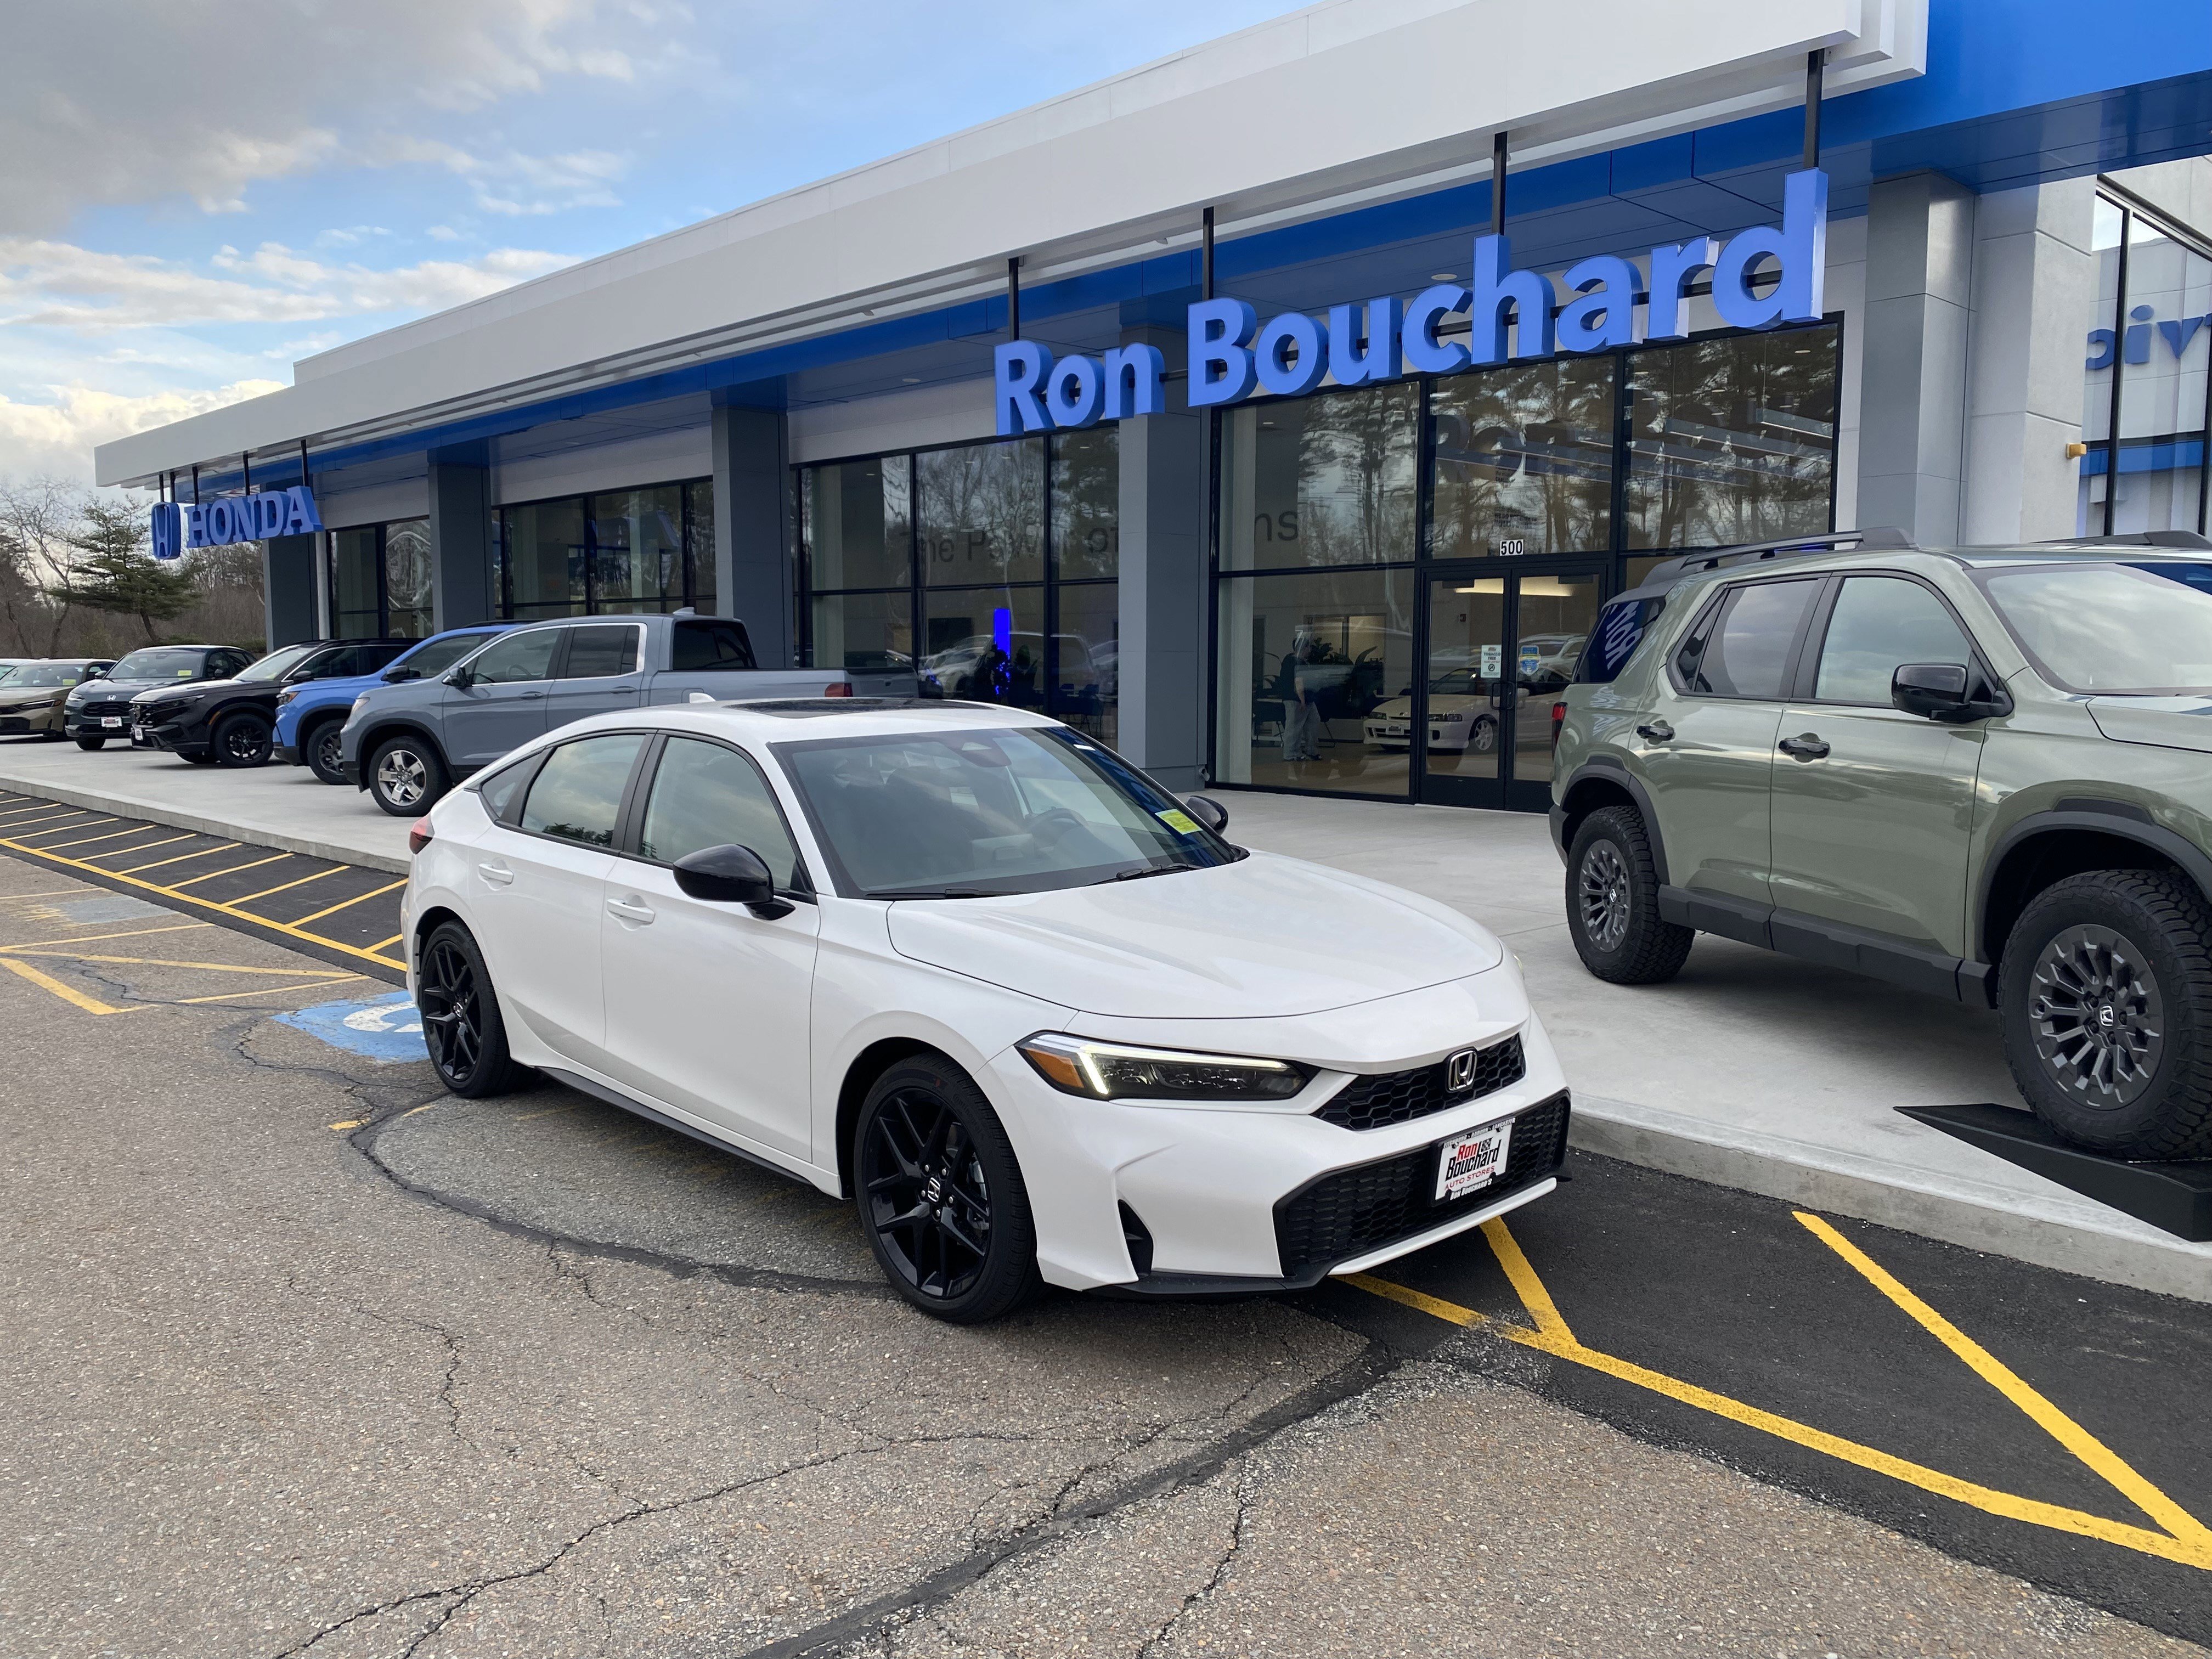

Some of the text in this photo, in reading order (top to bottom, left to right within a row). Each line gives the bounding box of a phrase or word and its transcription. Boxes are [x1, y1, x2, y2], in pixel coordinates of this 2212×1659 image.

[994, 167, 1829, 436] Ron Bouchard
[184, 486, 324, 548] HONDA
[1501, 540, 1522, 555] 500
[1445, 1139, 1502, 1182] Bouchard
[1457, 1143, 1479, 1161] Ron
[1444, 1165, 1495, 1191] AUTO STORES
